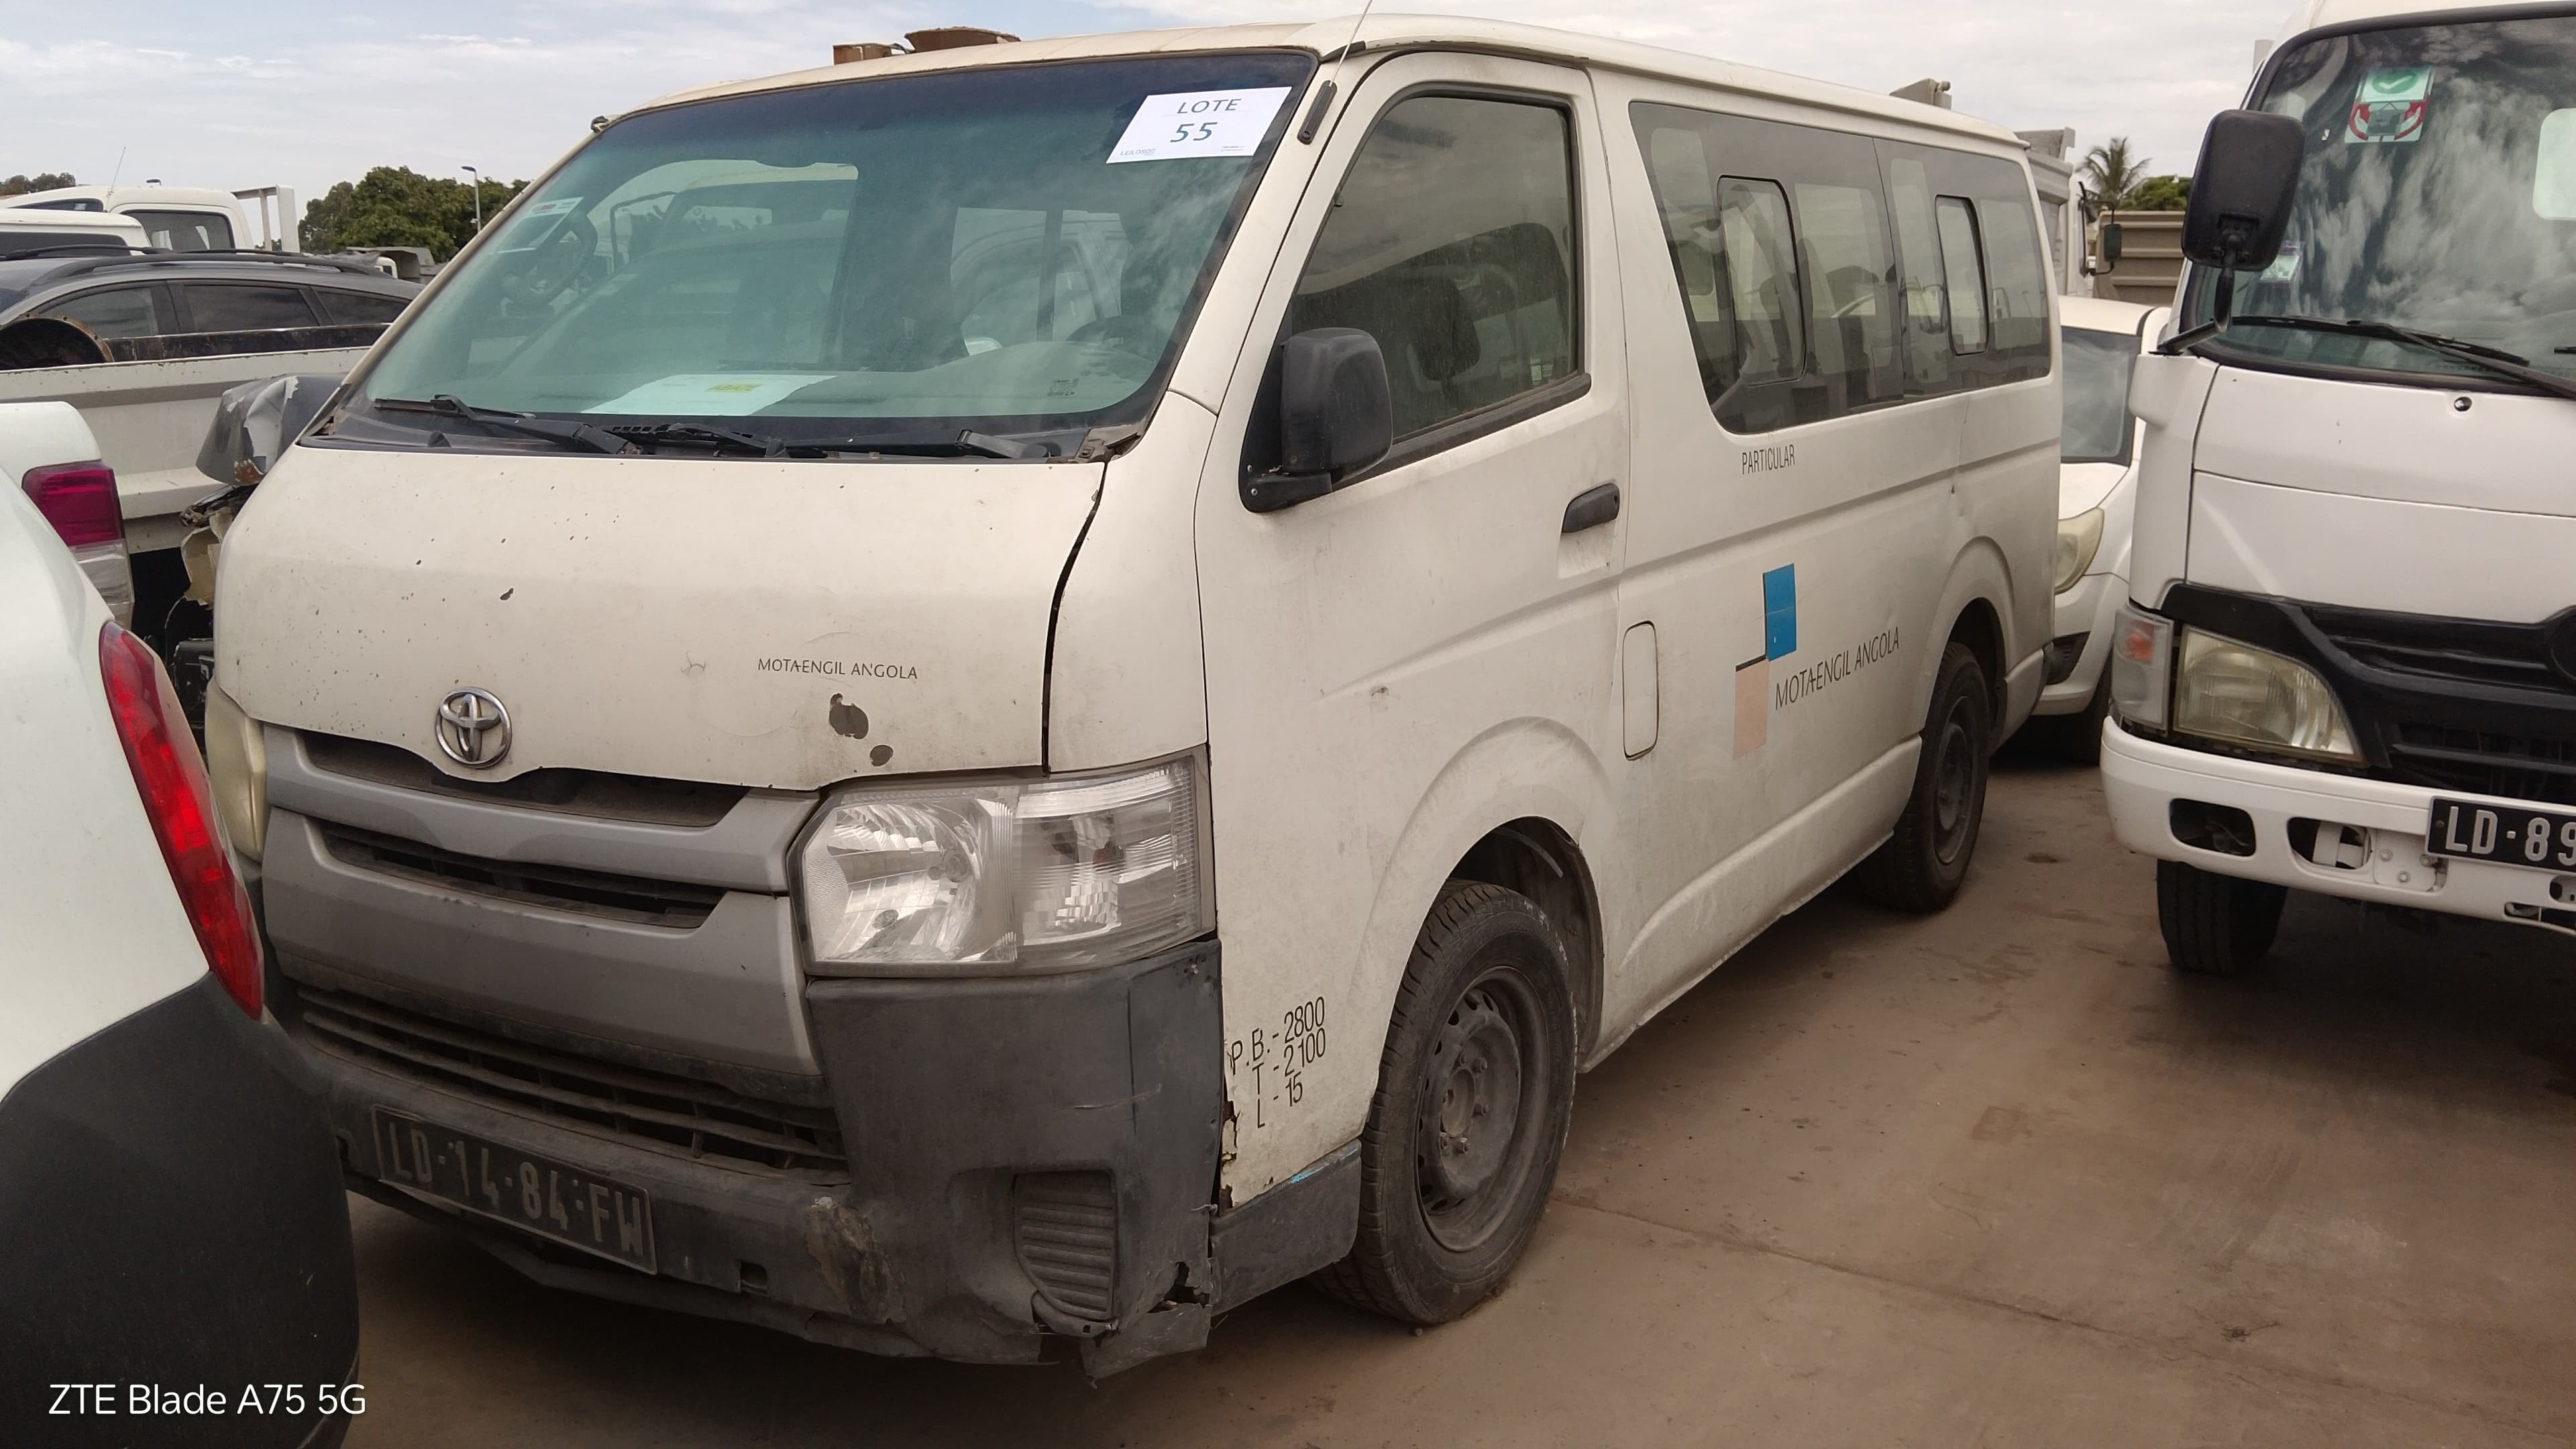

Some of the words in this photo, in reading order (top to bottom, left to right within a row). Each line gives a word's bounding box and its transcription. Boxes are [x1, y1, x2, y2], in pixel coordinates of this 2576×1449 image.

[1177, 99, 1242, 114] LOTE
[1169, 122, 1218, 143] 55
[1741, 444, 1795, 475] PARTICULAR
[1854, 626, 1900, 672] ANGOLA
[851, 663, 918, 680] ANGOLA
[1283, 996, 1325, 1044] 2800
[1283, 1027, 1326, 1077] 2100
[1285, 1071, 1303, 1107] 15
